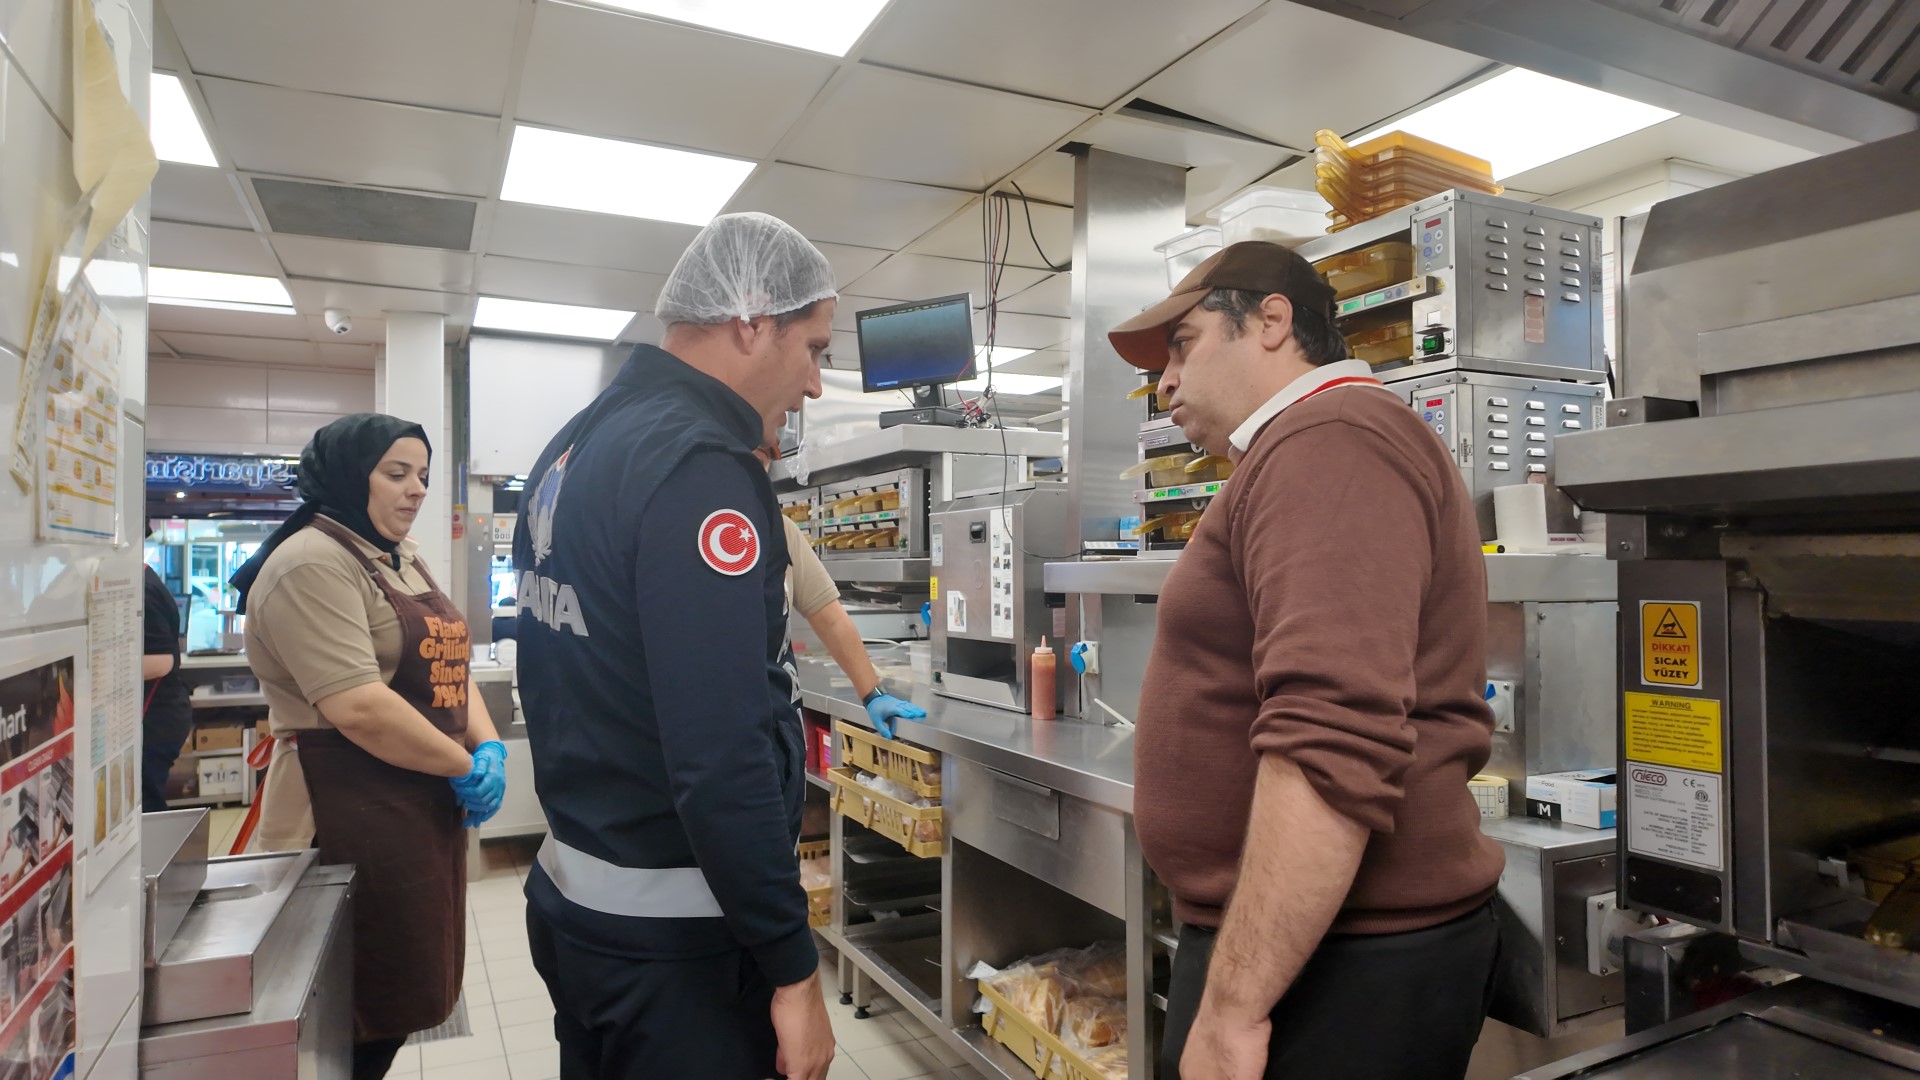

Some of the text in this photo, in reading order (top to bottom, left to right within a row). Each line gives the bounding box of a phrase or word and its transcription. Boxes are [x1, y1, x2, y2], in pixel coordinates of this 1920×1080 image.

[423, 616, 466, 638] Flame
[1654, 656, 1687, 666] SICAK
[429, 660, 466, 684] Since
[1653, 667, 1689, 679] YÜZEY
[431, 683, 466, 709] 1954
[1651, 699, 1692, 710] WARNING
[1539, 803, 1551, 817] M
